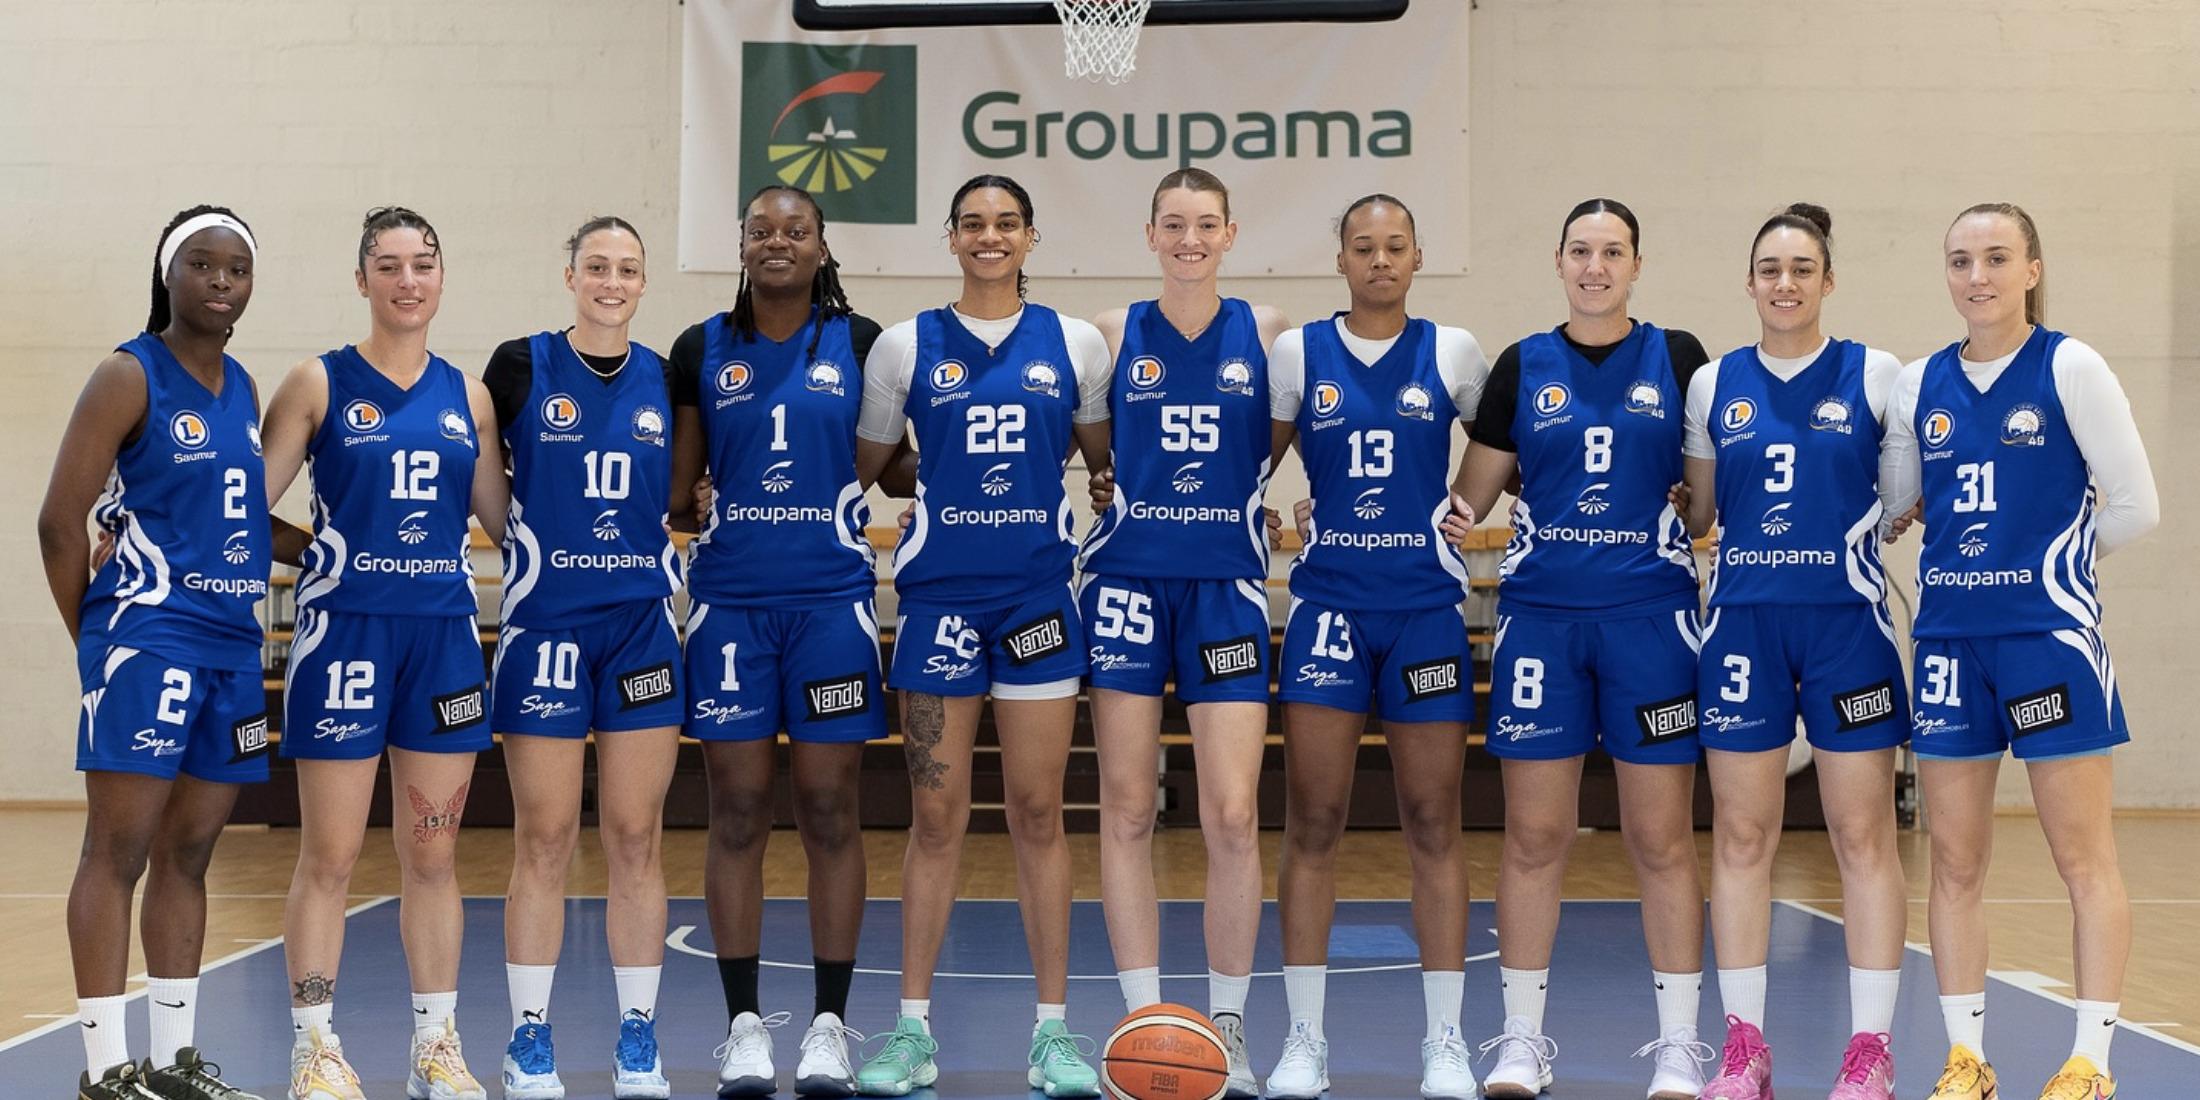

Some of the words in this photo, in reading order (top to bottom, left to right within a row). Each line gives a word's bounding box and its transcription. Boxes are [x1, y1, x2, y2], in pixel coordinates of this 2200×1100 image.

[962, 90, 1412, 169] Groupama
[716, 392, 754, 410] Saumur
[930, 391, 971, 407] Saumur
[1126, 391, 1167, 403] Saumur
[344, 434, 391, 447] Saumur
[540, 427, 584, 442] Saumur
[770, 404, 788, 451] 1
[966, 404, 1026, 454] 22
[1161, 405, 1221, 452] 55
[1533, 415, 1573, 432] Saumur
[1720, 431, 1756, 448] Saumur
[173, 451, 218, 464] Saumur
[1347, 429, 1394, 478] 13
[1584, 426, 1614, 474] 8
[1764, 443, 1796, 493] 3
[223, 467, 247, 520] 2
[390, 449, 440, 501] 12
[583, 450, 632, 500] 10
[1952, 460, 1997, 513] 31
[726, 503, 833, 525] Groupama
[940, 506, 1048, 528] Groupama
[1130, 501, 1240, 525] Groupama
[1538, 523, 1649, 547] Groupama
[1319, 528, 1426, 552] Groupama
[1725, 547, 1836, 569] Groupama
[353, 551, 458, 578] Groupama
[1925, 567, 2033, 591] Groupama
[1094, 586, 1155, 645] 55
[1310, 611, 1354, 662] 13
[324, 660, 375, 710] 12
[532, 640, 580, 690] 10
[720, 642, 740, 692] 1
[1512, 657, 1545, 710] 8
[1720, 654, 1751, 703] 3
[1920, 654, 1962, 707] 31
[156, 667, 192, 726] 2
[1151, 1071, 1180, 1087] FIBA
